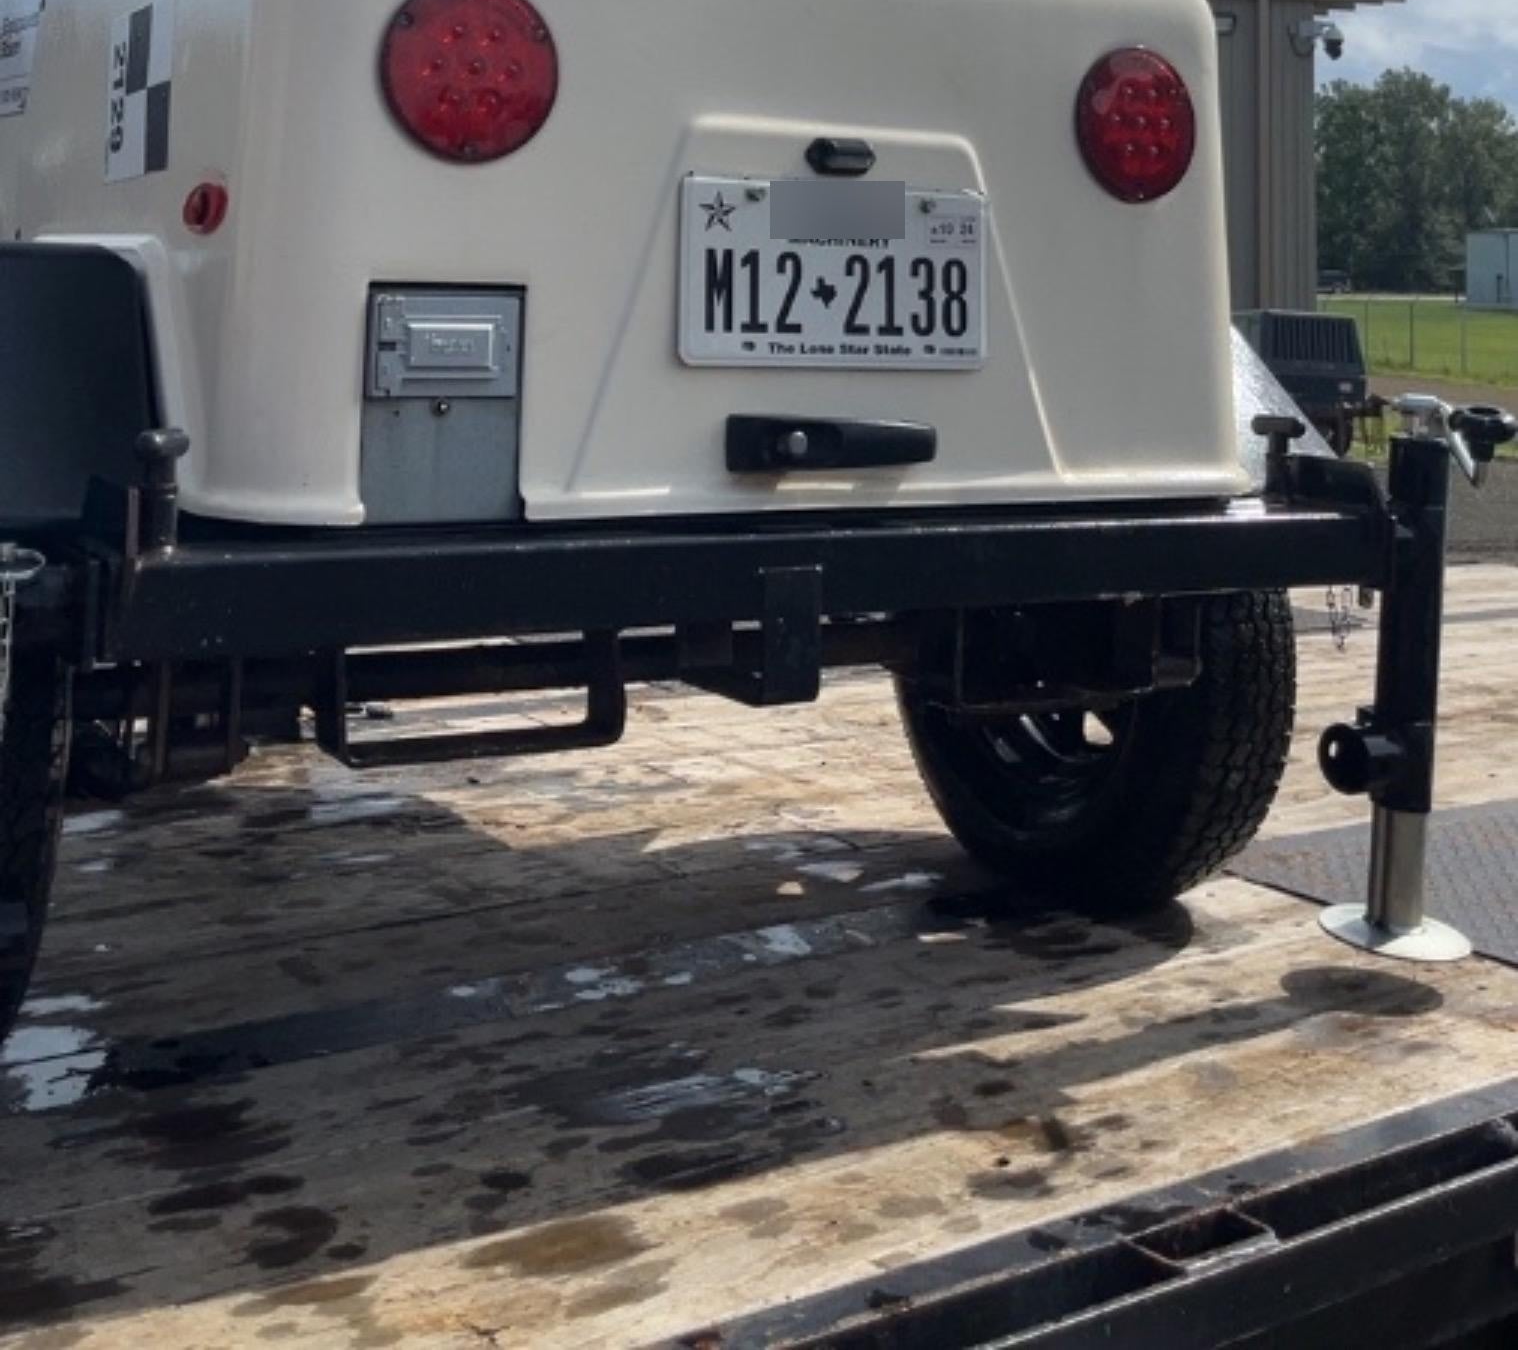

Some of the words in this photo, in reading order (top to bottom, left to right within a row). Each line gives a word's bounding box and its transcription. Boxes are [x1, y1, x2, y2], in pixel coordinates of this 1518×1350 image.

[704, 248, 803, 334] M12
[843, 254, 968, 338] 2138
[768, 342, 796, 355] The
[800, 342, 835, 355] Lone
[839, 343, 869, 356] Star
[874, 344, 912, 356] State
